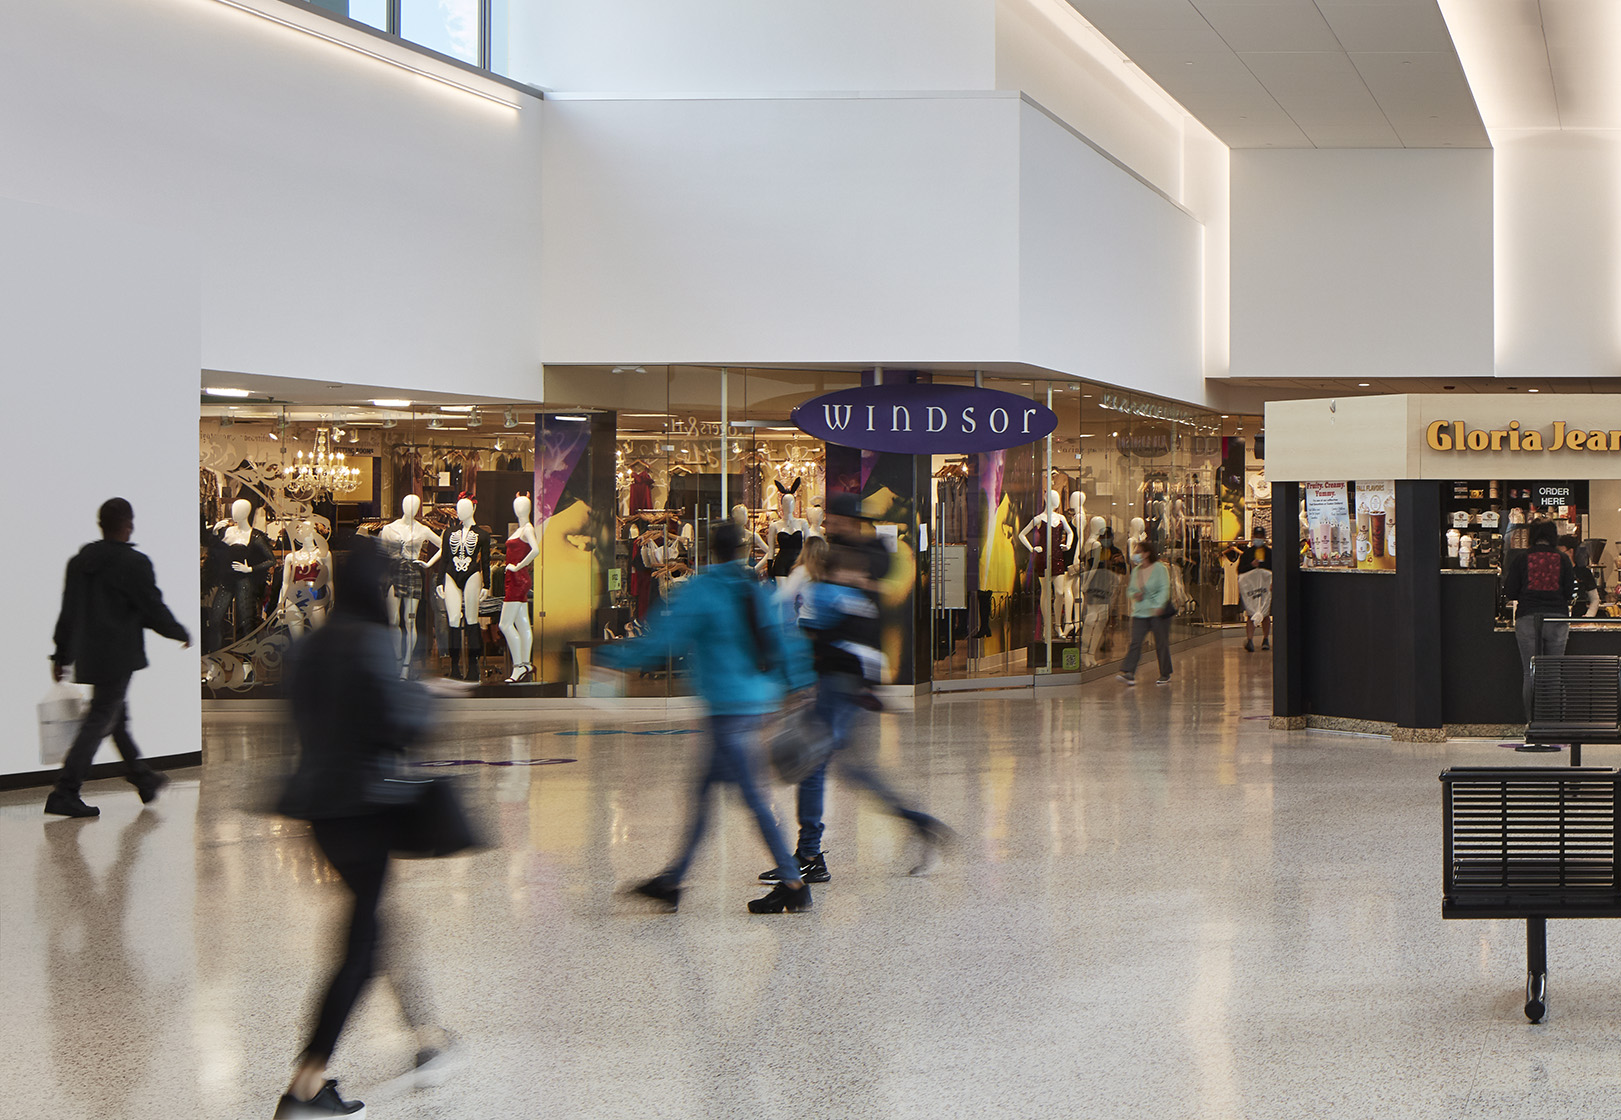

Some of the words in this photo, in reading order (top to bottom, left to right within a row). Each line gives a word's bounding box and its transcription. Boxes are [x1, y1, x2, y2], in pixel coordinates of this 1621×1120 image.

[822, 403, 1037, 434] WINDSOR
[1426, 420, 1543, 451] Gloria
[1538, 487, 1570, 496] ORDER
[1541, 497, 1566, 506] HERE
